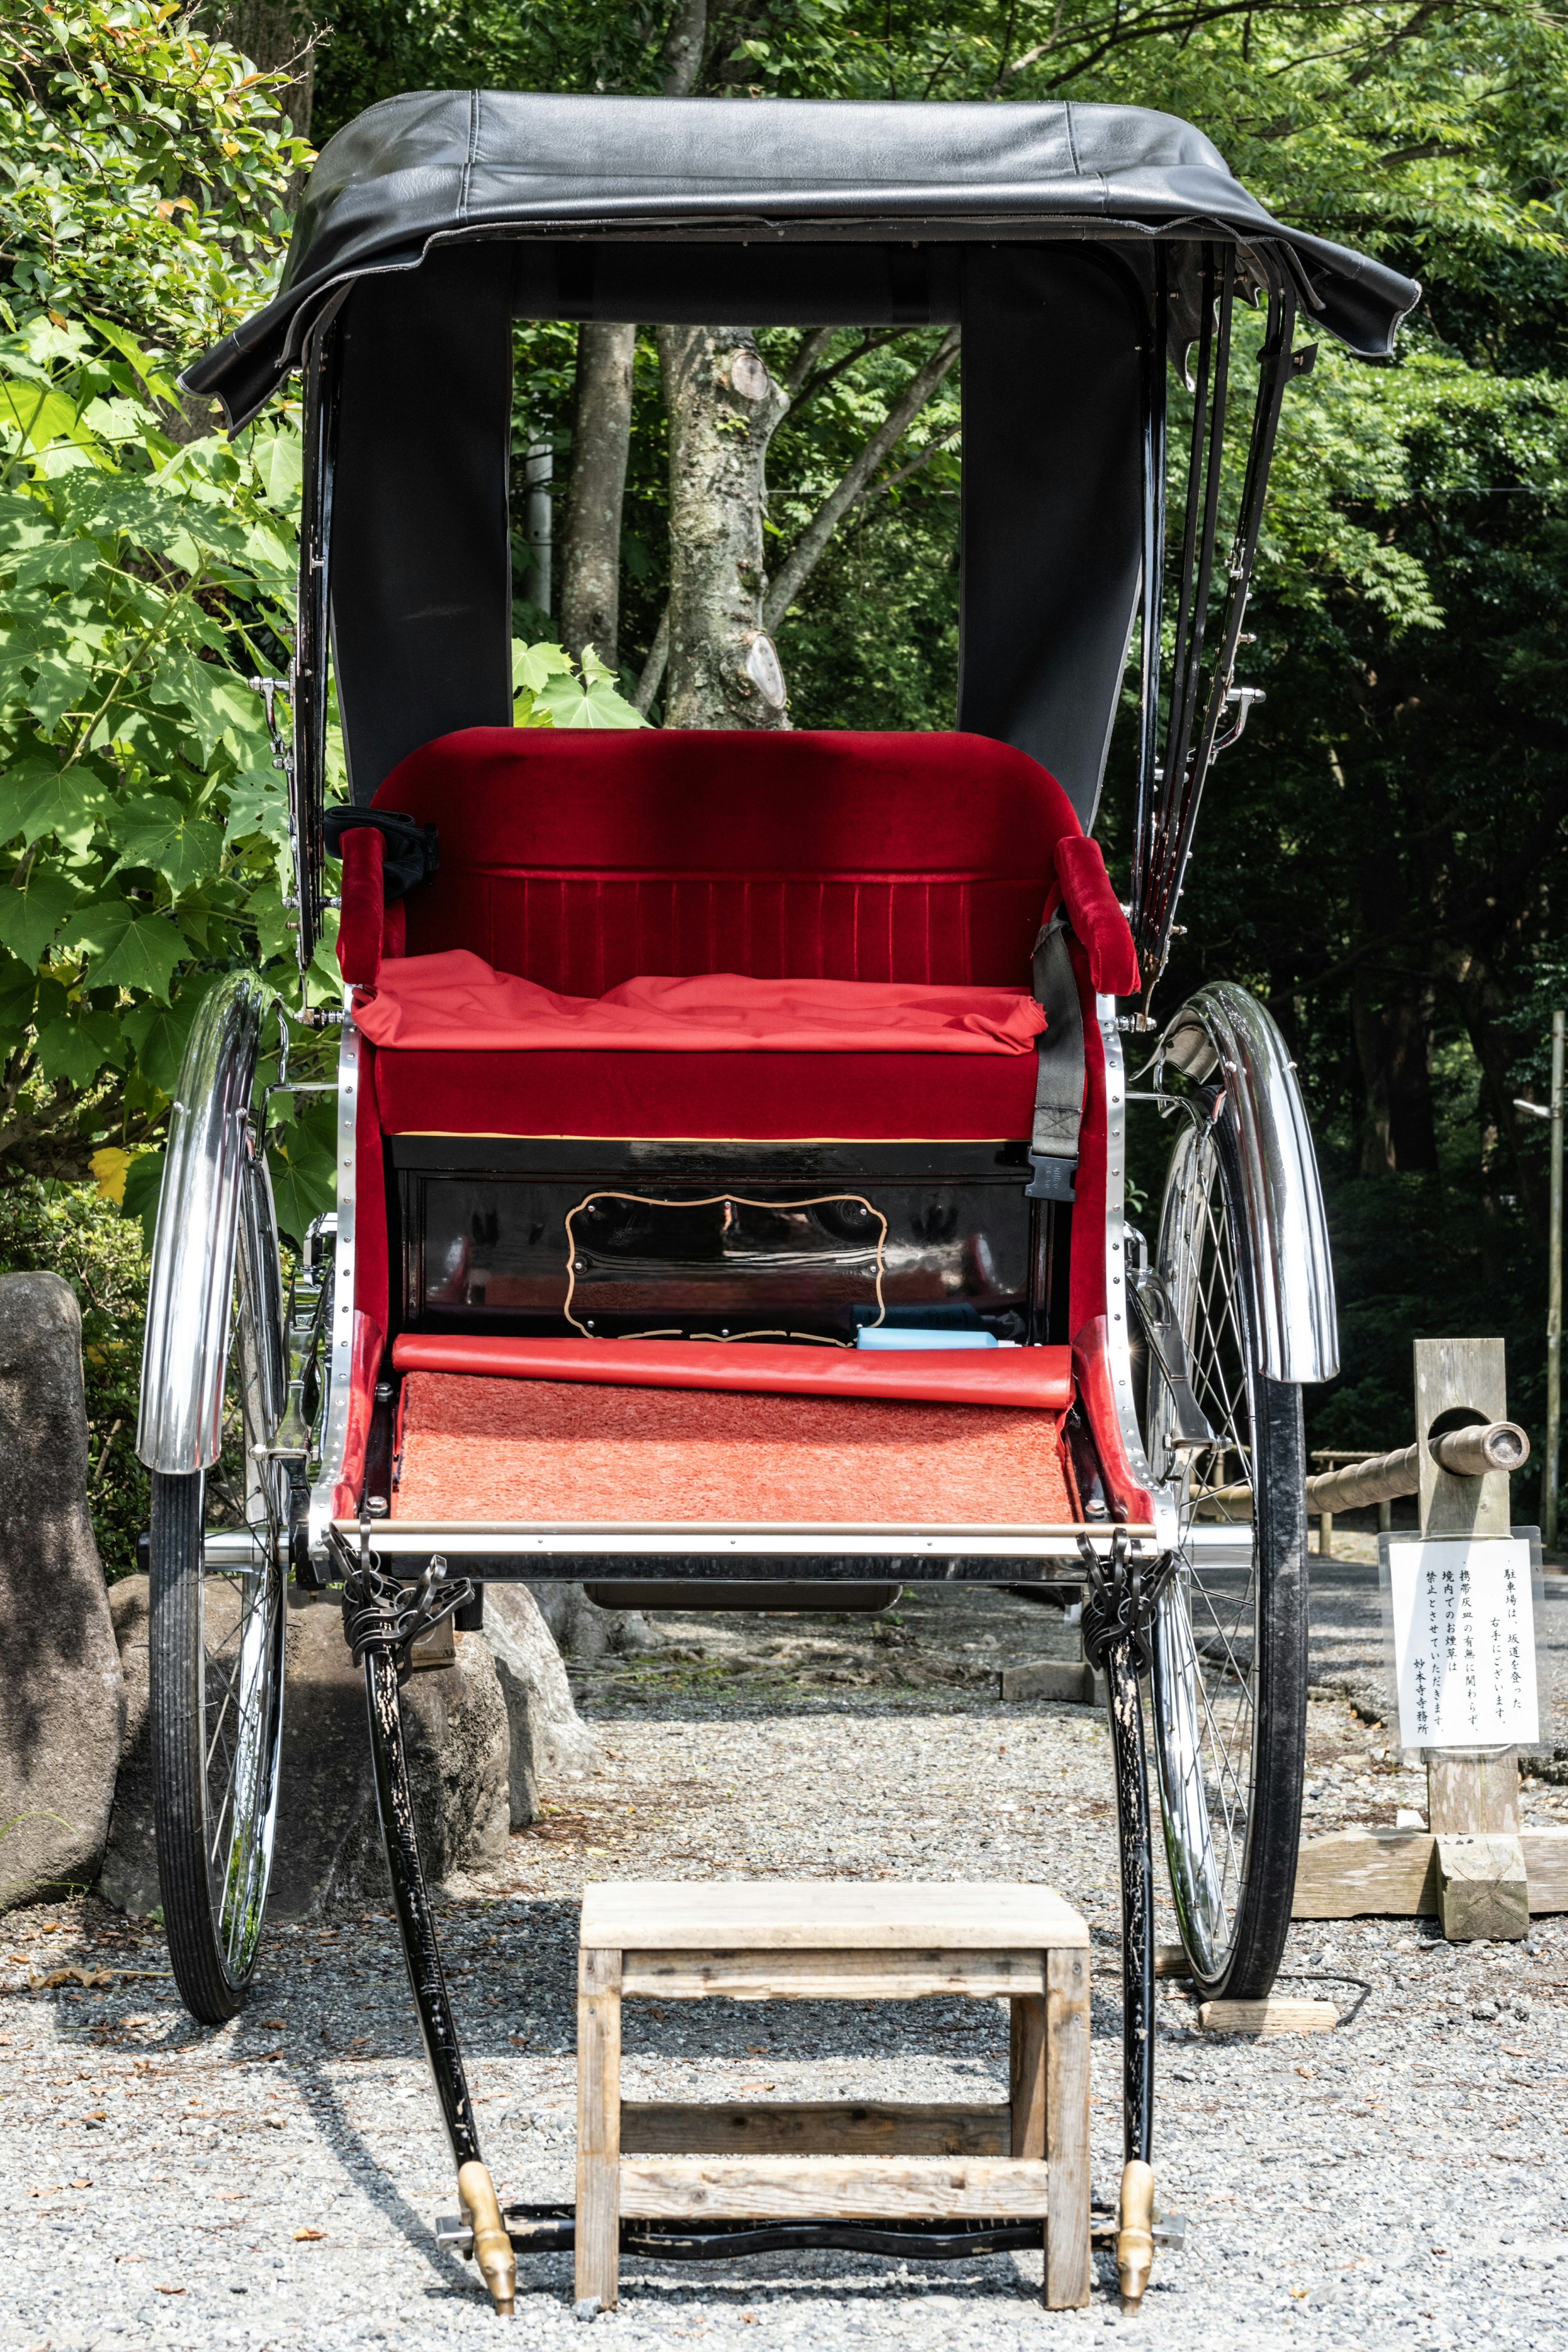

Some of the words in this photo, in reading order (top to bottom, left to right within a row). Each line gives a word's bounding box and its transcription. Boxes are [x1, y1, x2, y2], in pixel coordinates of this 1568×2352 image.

[1426, 1570, 1444, 1732] 禁止とさせていただきます。
[1442, 1570, 1457, 1672] 境内でのお煙草は
[1490, 1617, 1506, 1724] 右手にございます。
[1413, 1658, 1429, 1735] 妙本寺寺務所
